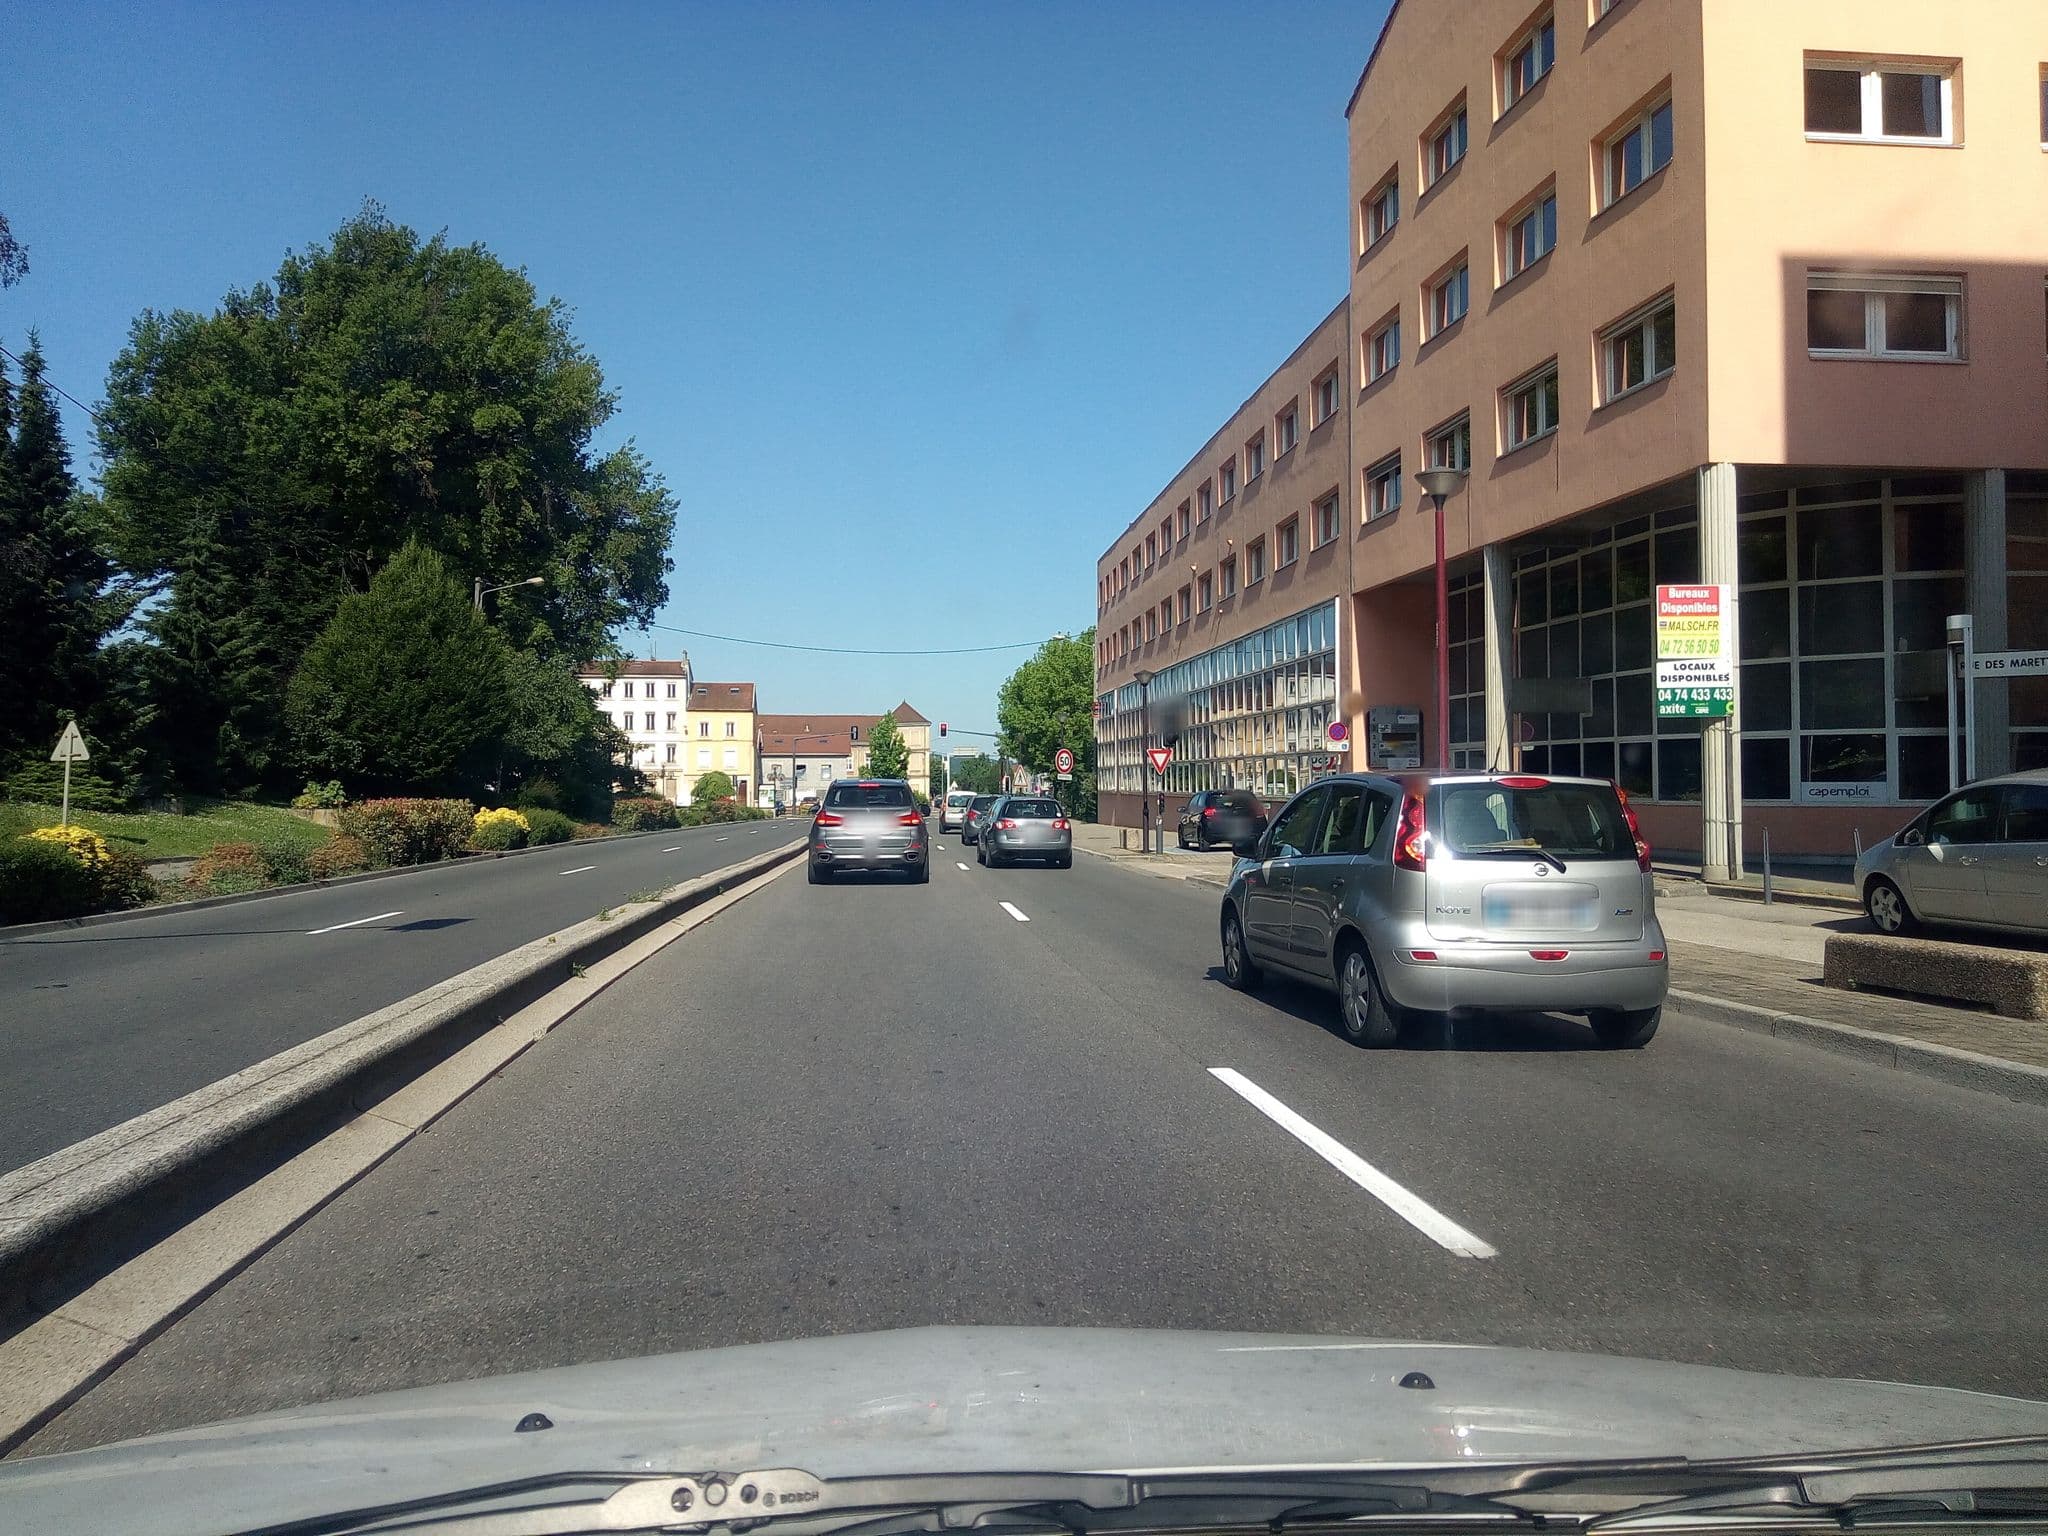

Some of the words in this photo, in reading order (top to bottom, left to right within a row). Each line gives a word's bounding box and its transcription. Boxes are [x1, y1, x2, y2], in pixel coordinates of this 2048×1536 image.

[1668, 587, 1710, 598] Bureaux
[1661, 602, 1717, 615] Disponibles
[1668, 621, 1719, 631] MALSCH.FR
[1660, 640, 1669, 654] 04
[1673, 640, 1682, 654] 72
[1673, 663, 1715, 671] LOCAUX
[1985, 660, 2005, 669] DES
[2010, 657, 2048, 668] MARET
[1660, 674, 1730, 682] DISPONIBLES
[1658, 689, 1672, 701] 04
[1675, 689, 1688, 701] 74
[1690, 688, 1710, 701] 433
[1713, 688, 1733, 700] 433
[1660, 703, 1686, 714] axite
[1060, 756, 1070, 766] 50
[780, 1491, 819, 1504] BOSCH
